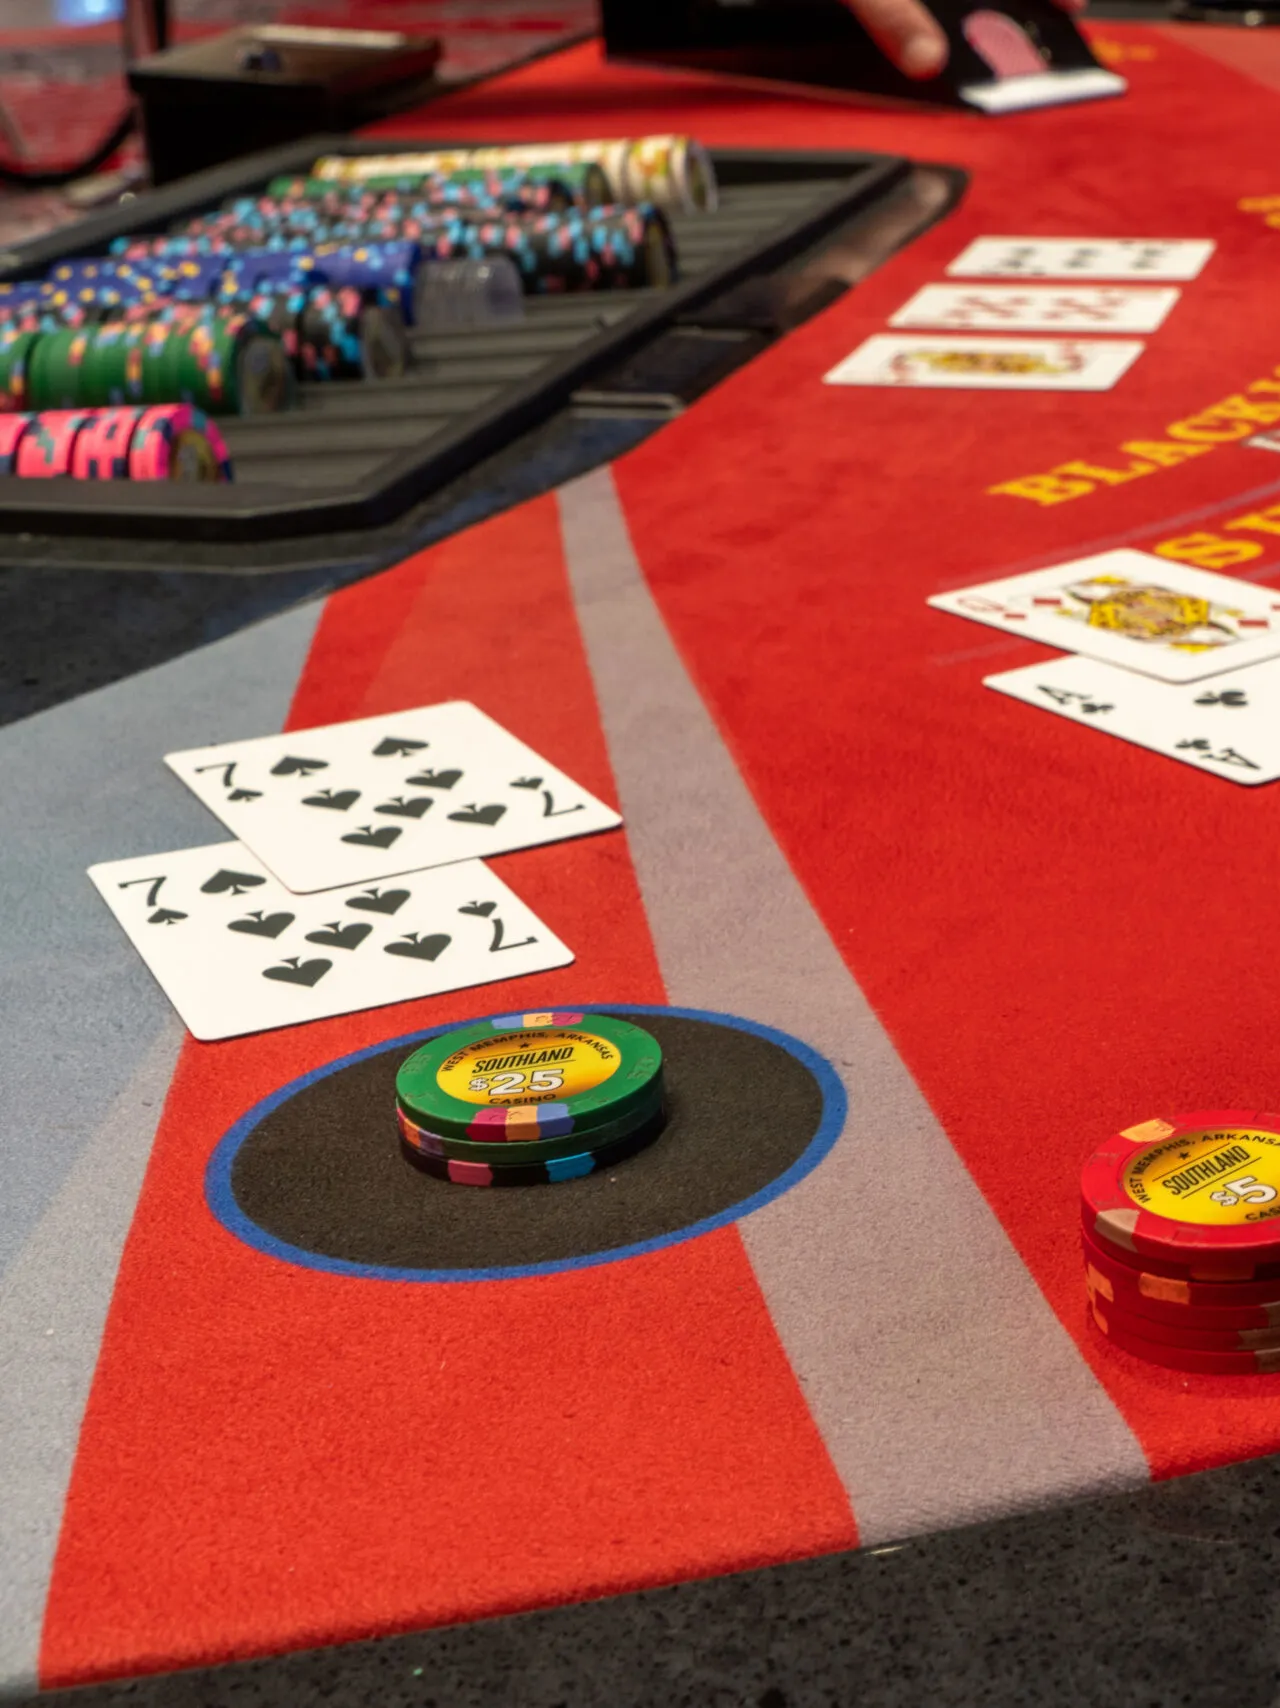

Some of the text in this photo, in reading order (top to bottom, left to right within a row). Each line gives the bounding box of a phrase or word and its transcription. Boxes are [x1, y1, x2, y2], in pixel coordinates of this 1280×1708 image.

[194, 761, 238, 788] 7
[542, 790, 586, 818] 7
[117, 876, 167, 907] 7
[488, 917, 539, 953] 7
[440, 1050, 469, 1072] WEST
[554, 1031, 615, 1060] ARKANSAS
[472, 1046, 574, 1075] SOUTHLAND
[467, 1068, 565, 1097] $25
[489, 1093, 557, 1105] CASINO
[1161, 1144, 1251, 1197] SOUTHLAND
[1128, 1177, 1152, 1204] WEST
[1209, 1175, 1278, 1208] $5
